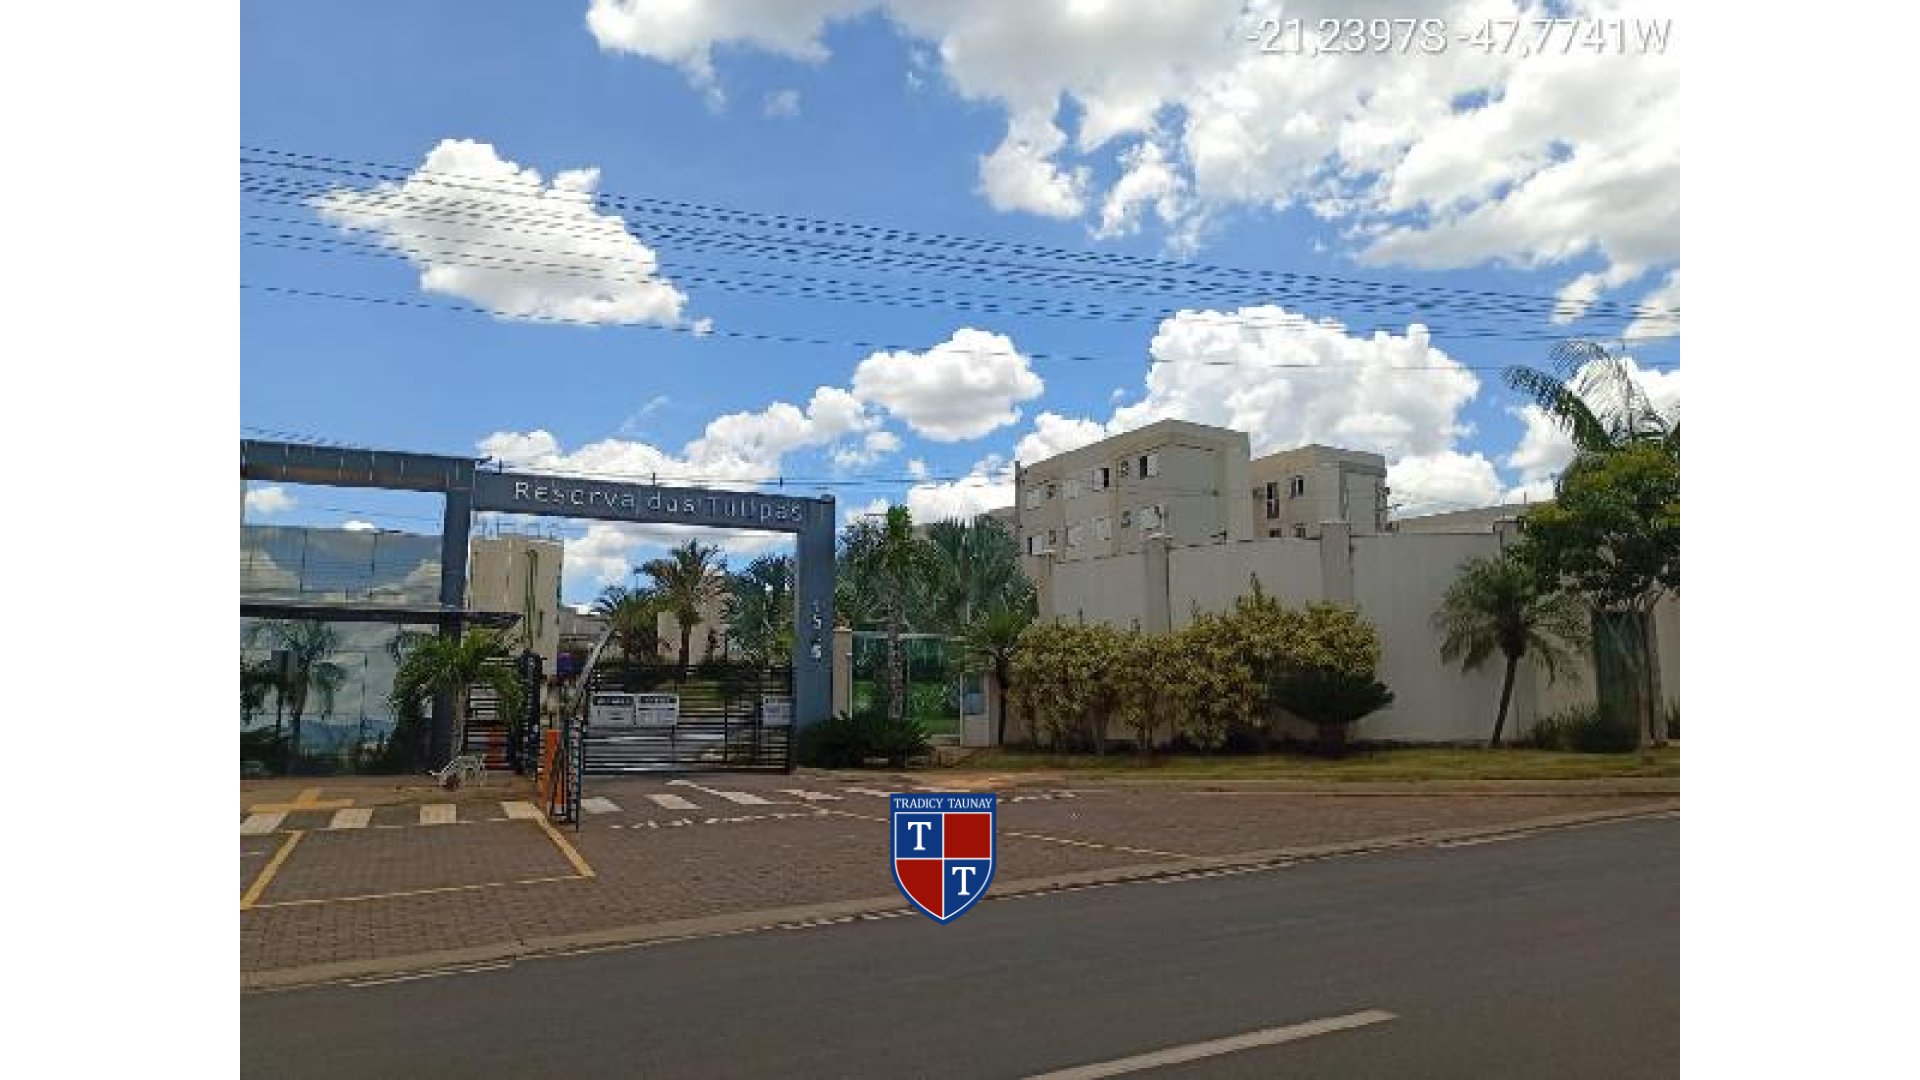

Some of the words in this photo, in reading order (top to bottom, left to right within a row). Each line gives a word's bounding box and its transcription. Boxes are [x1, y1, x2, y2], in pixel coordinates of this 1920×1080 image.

[513, 480, 635, 508] Reserva
[648, 491, 696, 514] das
[706, 497, 803, 523] Tulipas
